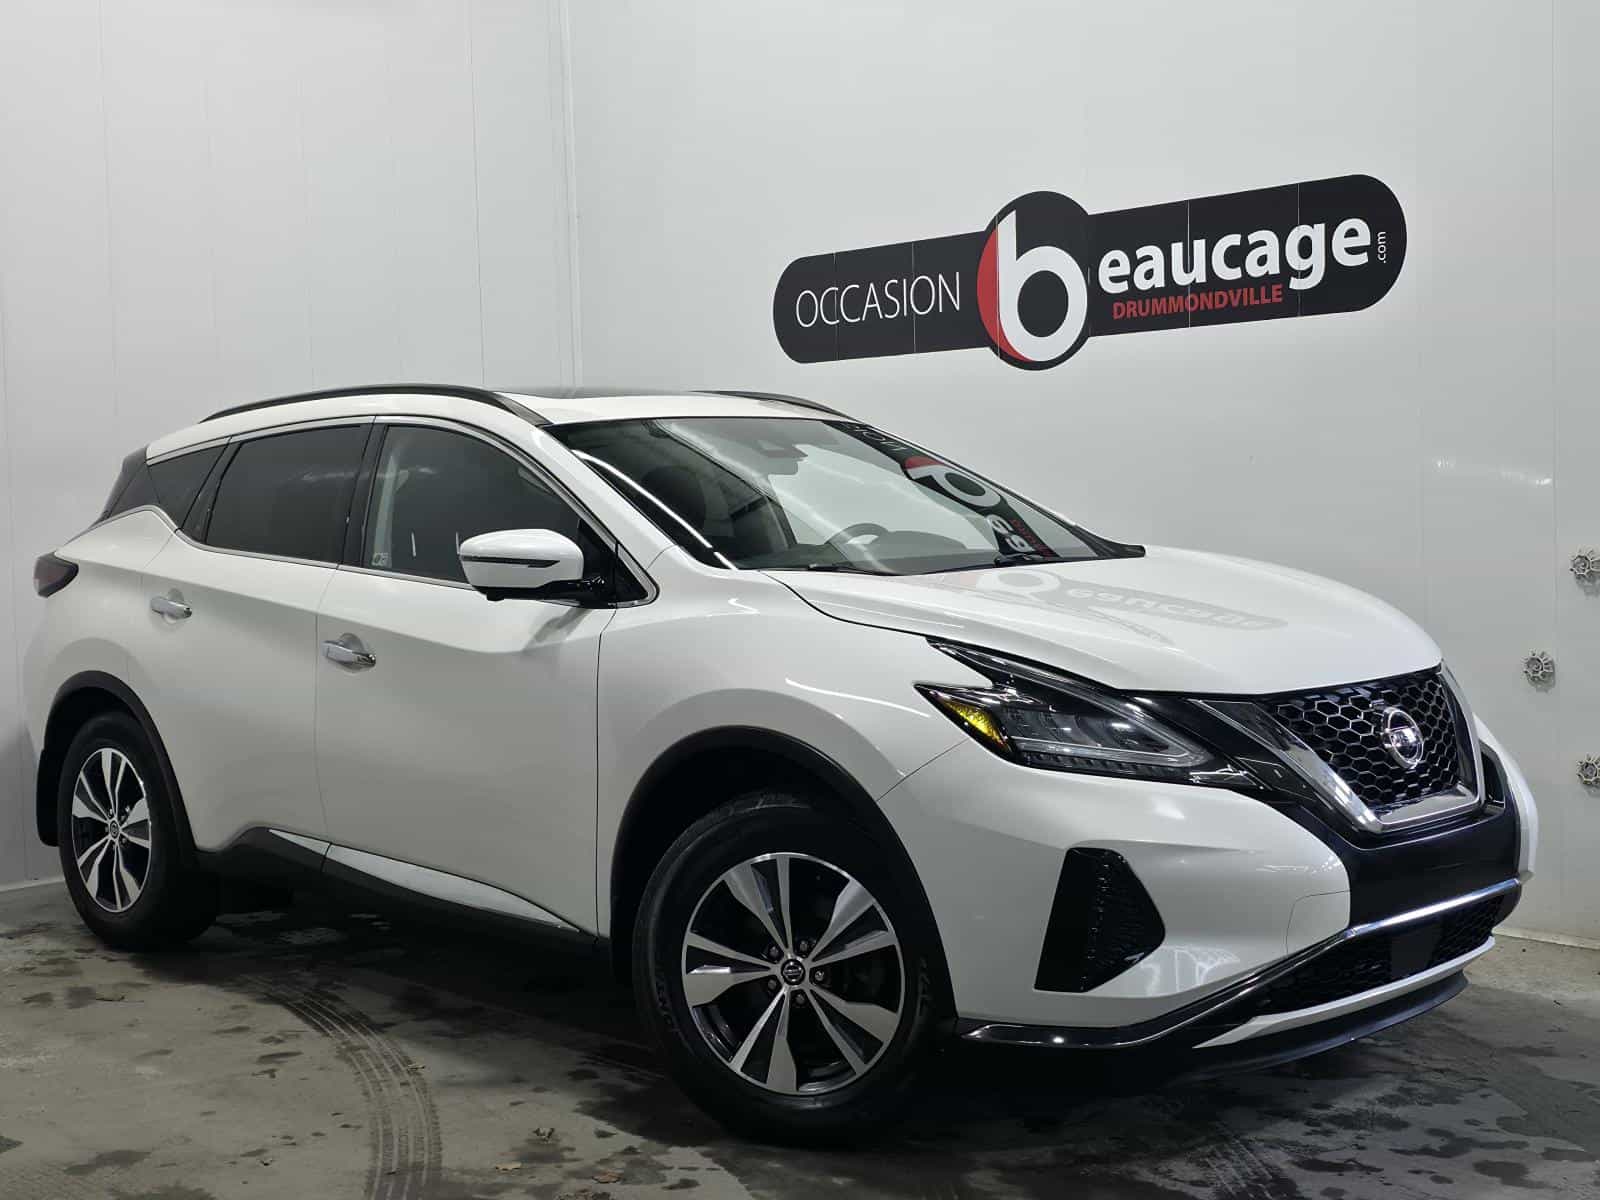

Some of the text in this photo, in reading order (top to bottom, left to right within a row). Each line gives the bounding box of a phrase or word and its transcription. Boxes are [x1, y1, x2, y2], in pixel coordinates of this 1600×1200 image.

[796, 272, 960, 328] OCCASION
[1376, 231, 1386, 264] .com
[1113, 284, 1283, 320] DRUMMONDVILLE
